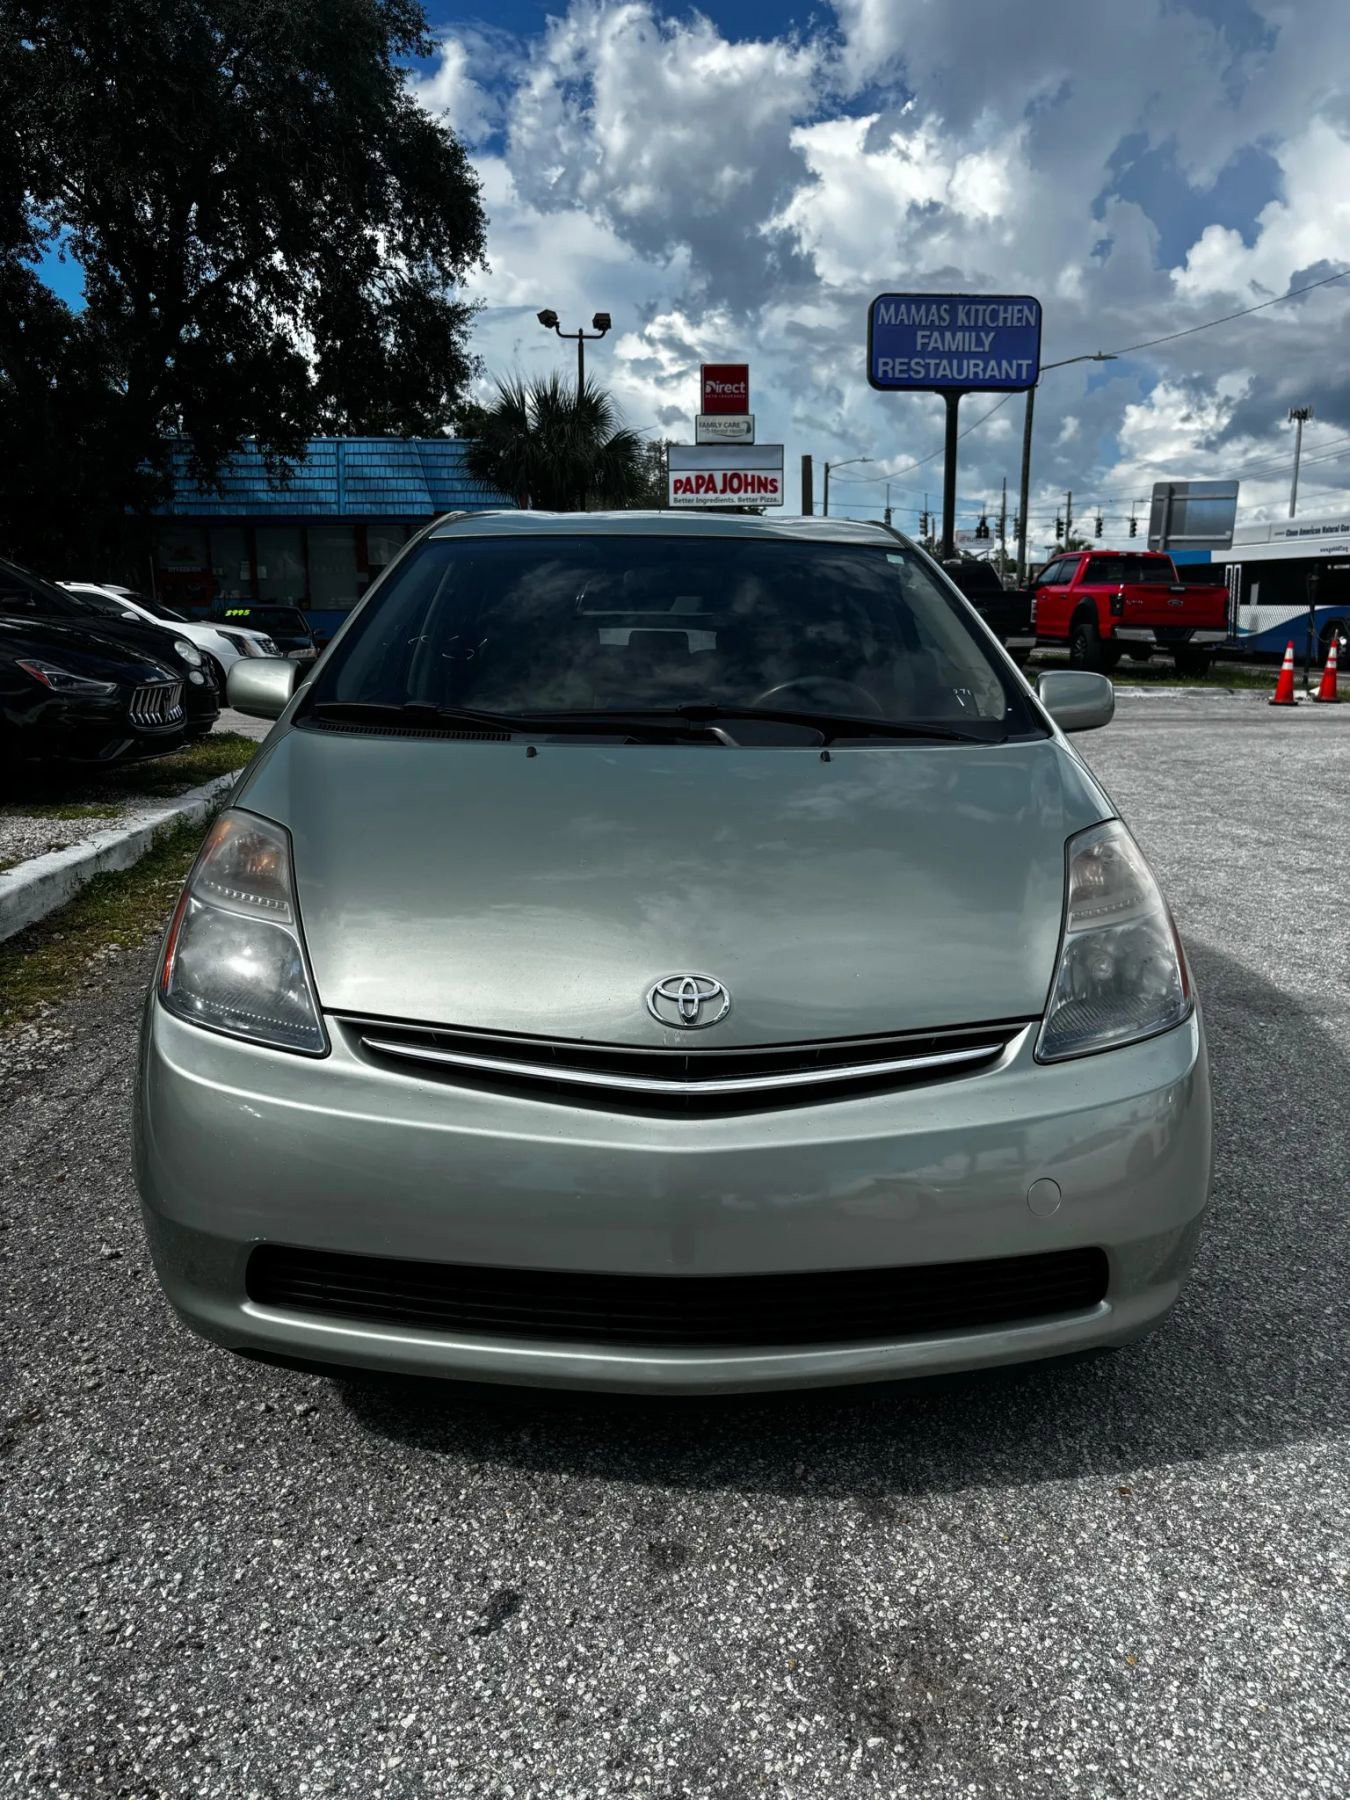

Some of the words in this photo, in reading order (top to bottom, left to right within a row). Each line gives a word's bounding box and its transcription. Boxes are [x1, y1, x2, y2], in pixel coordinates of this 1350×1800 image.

[878, 304, 950, 326] MAMAS
[957, 304, 1036, 327] KITCHEN
[916, 330, 996, 353] FAMILY
[878, 358, 1032, 380] RESTAURANT
[705, 380, 746, 394] Direct
[673, 473, 718, 495] PAPA
[719, 472, 779, 495] JOHNS
